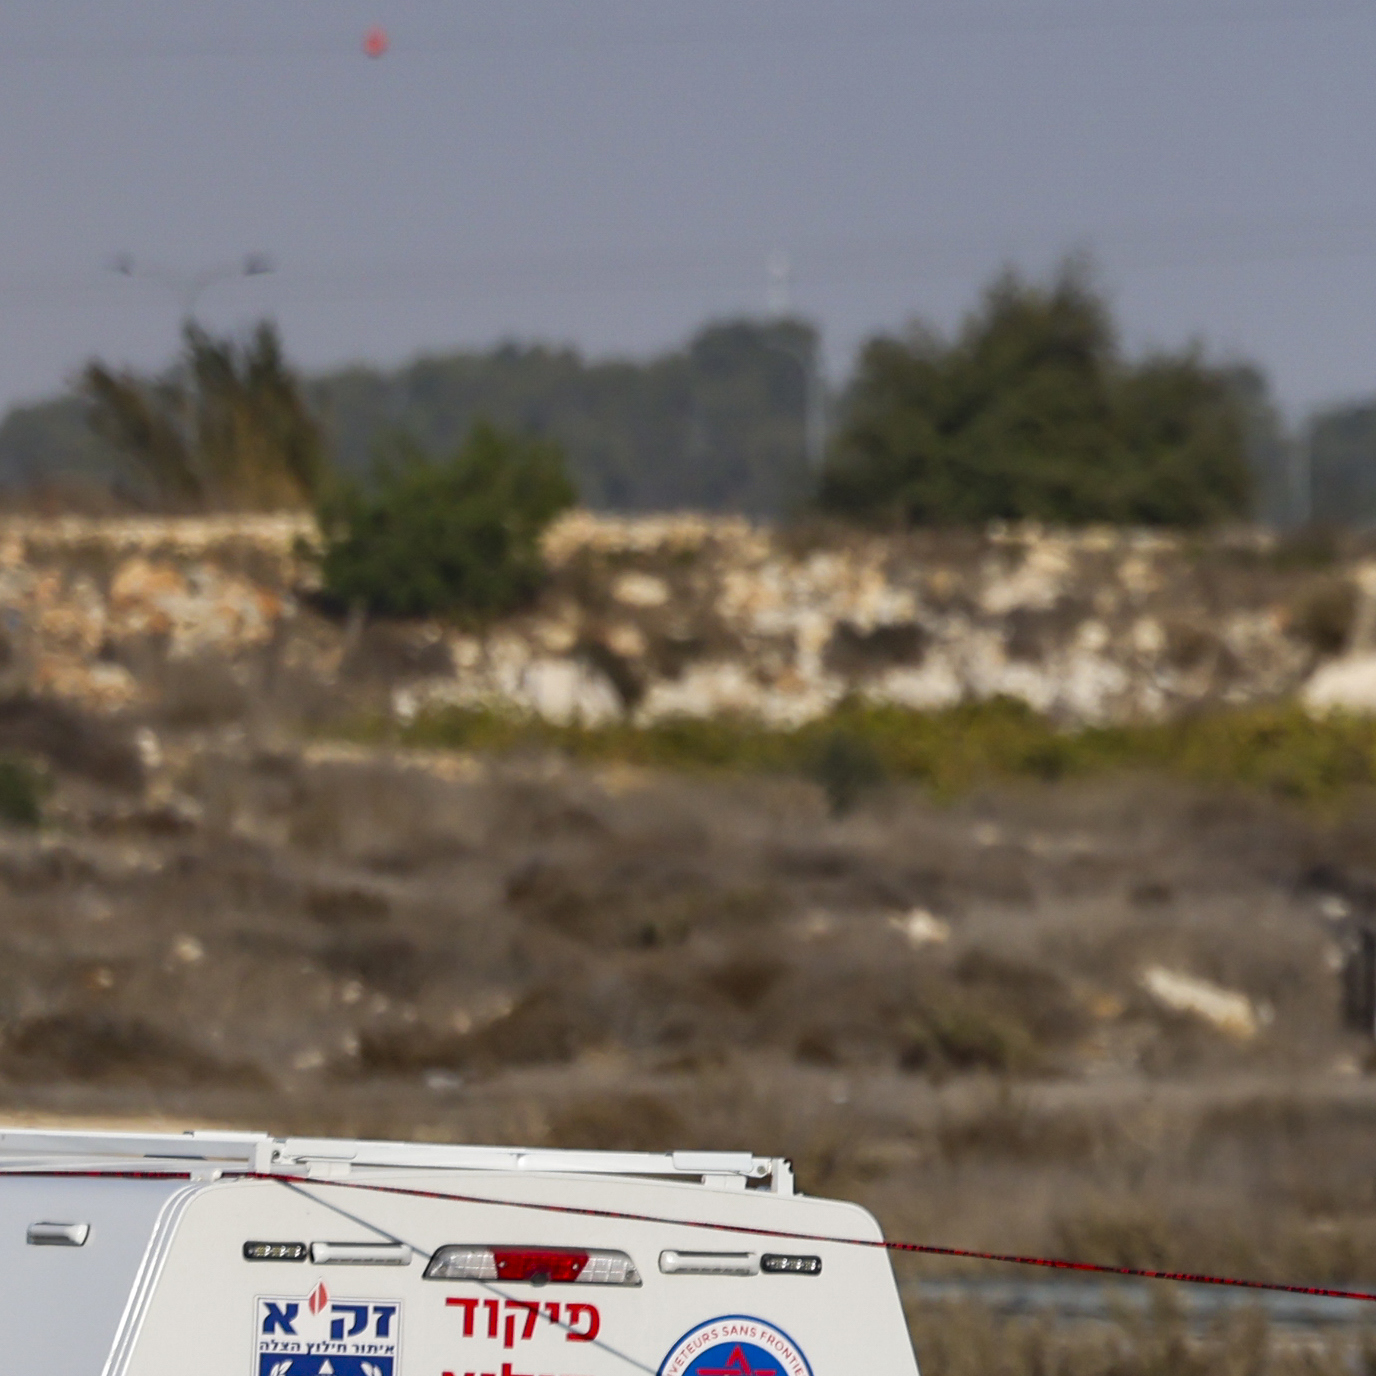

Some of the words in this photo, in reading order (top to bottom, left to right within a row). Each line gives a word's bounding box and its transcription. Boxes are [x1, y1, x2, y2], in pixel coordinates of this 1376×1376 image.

[447, 1298, 600, 1344] פיקוד
[722, 1325, 757, 1339] SANS
[259, 1340, 301, 1353] הצלה
[306, 1341, 347, 1356] חילוץ
[350, 1344, 395, 1355] איתור
